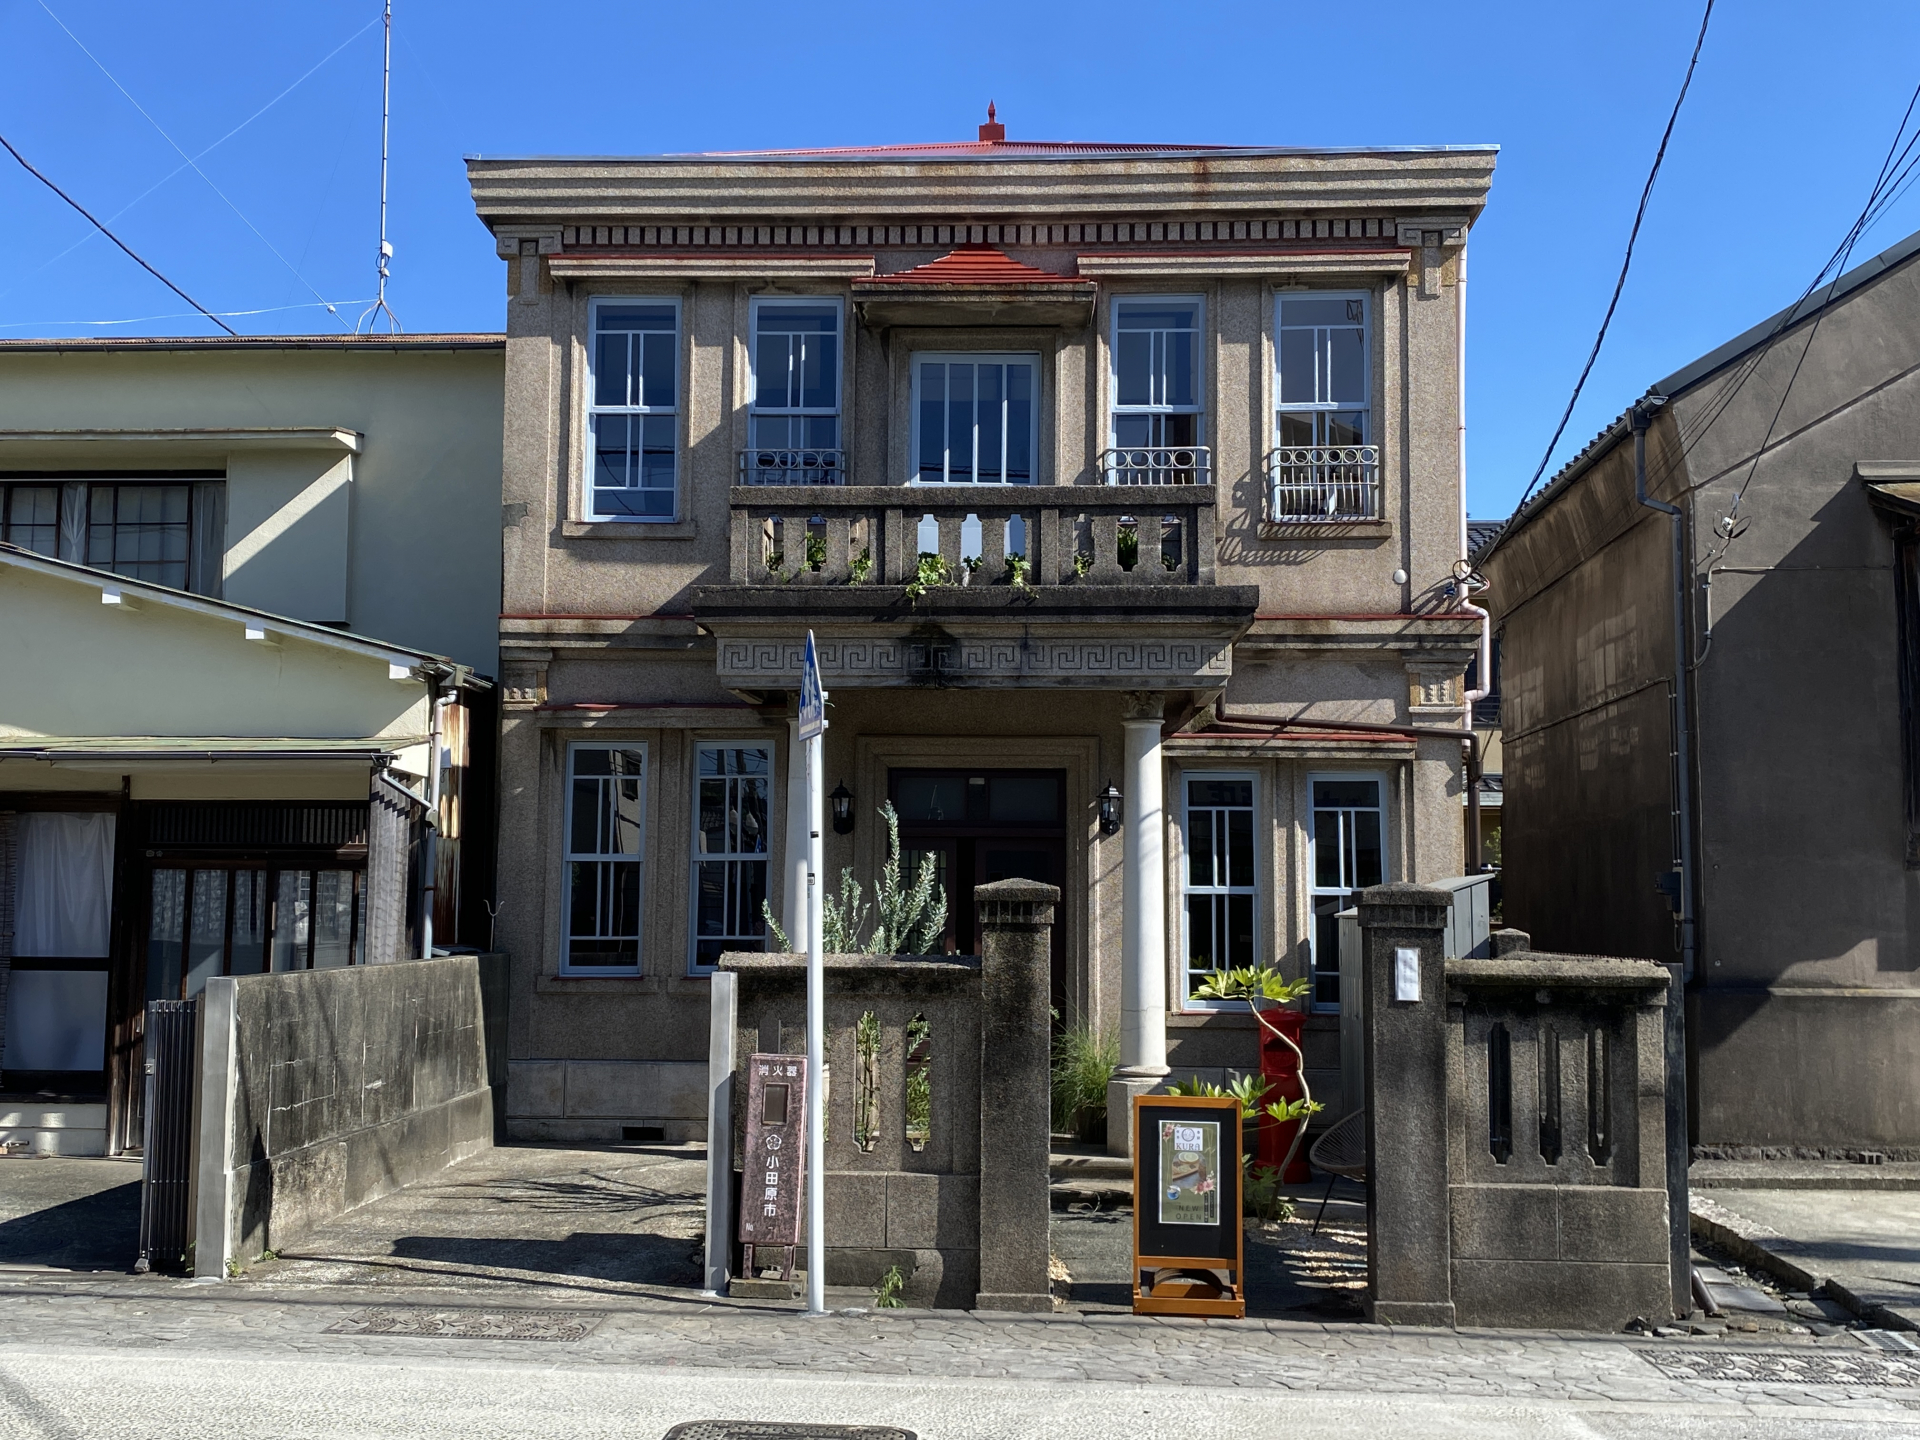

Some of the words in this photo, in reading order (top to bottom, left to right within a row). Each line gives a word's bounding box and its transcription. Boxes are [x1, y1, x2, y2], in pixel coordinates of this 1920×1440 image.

[758, 1064, 798, 1077] 消火器
[1176, 1142, 1201, 1151] KURA
[763, 1155, 779, 1217] 小田原市
